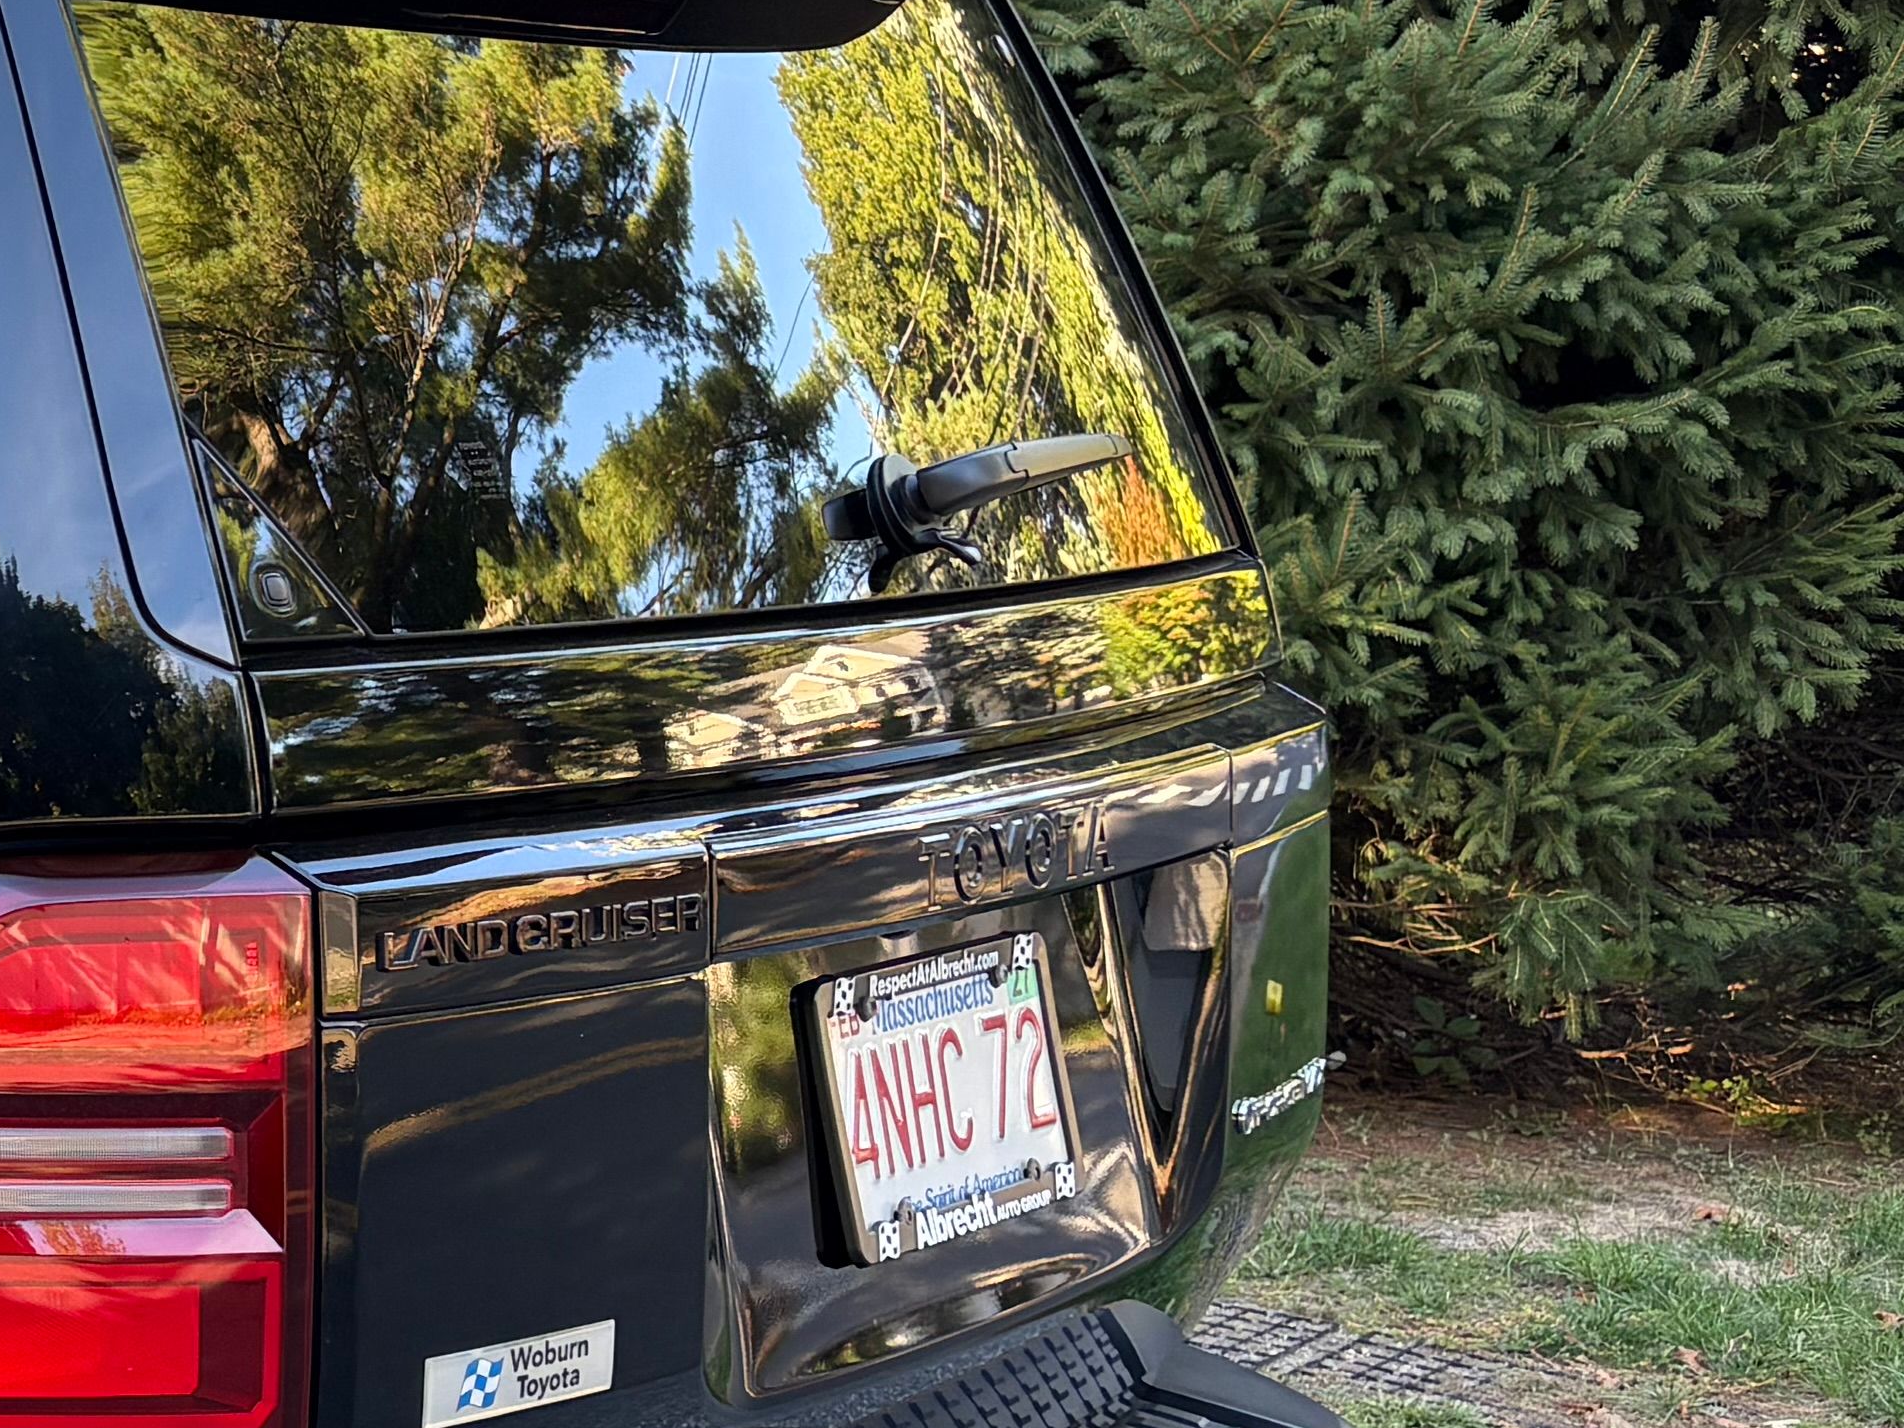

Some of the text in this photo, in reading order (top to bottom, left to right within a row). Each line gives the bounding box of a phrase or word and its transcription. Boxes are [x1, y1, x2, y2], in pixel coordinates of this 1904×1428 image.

[917, 801, 1116, 912] TOYOTA
[382, 892, 704, 972] LAND CRUISER
[869, 948, 999, 1000] RespectAtAlbrecht.com
[849, 1025, 975, 1181] 4NHC
[979, 1005, 1058, 1141] 72
[916, 1189, 1053, 1250] Albrecht AUTO GROUP
[510, 1338, 590, 1373] Woburn
[516, 1367, 582, 1401] Toyota
